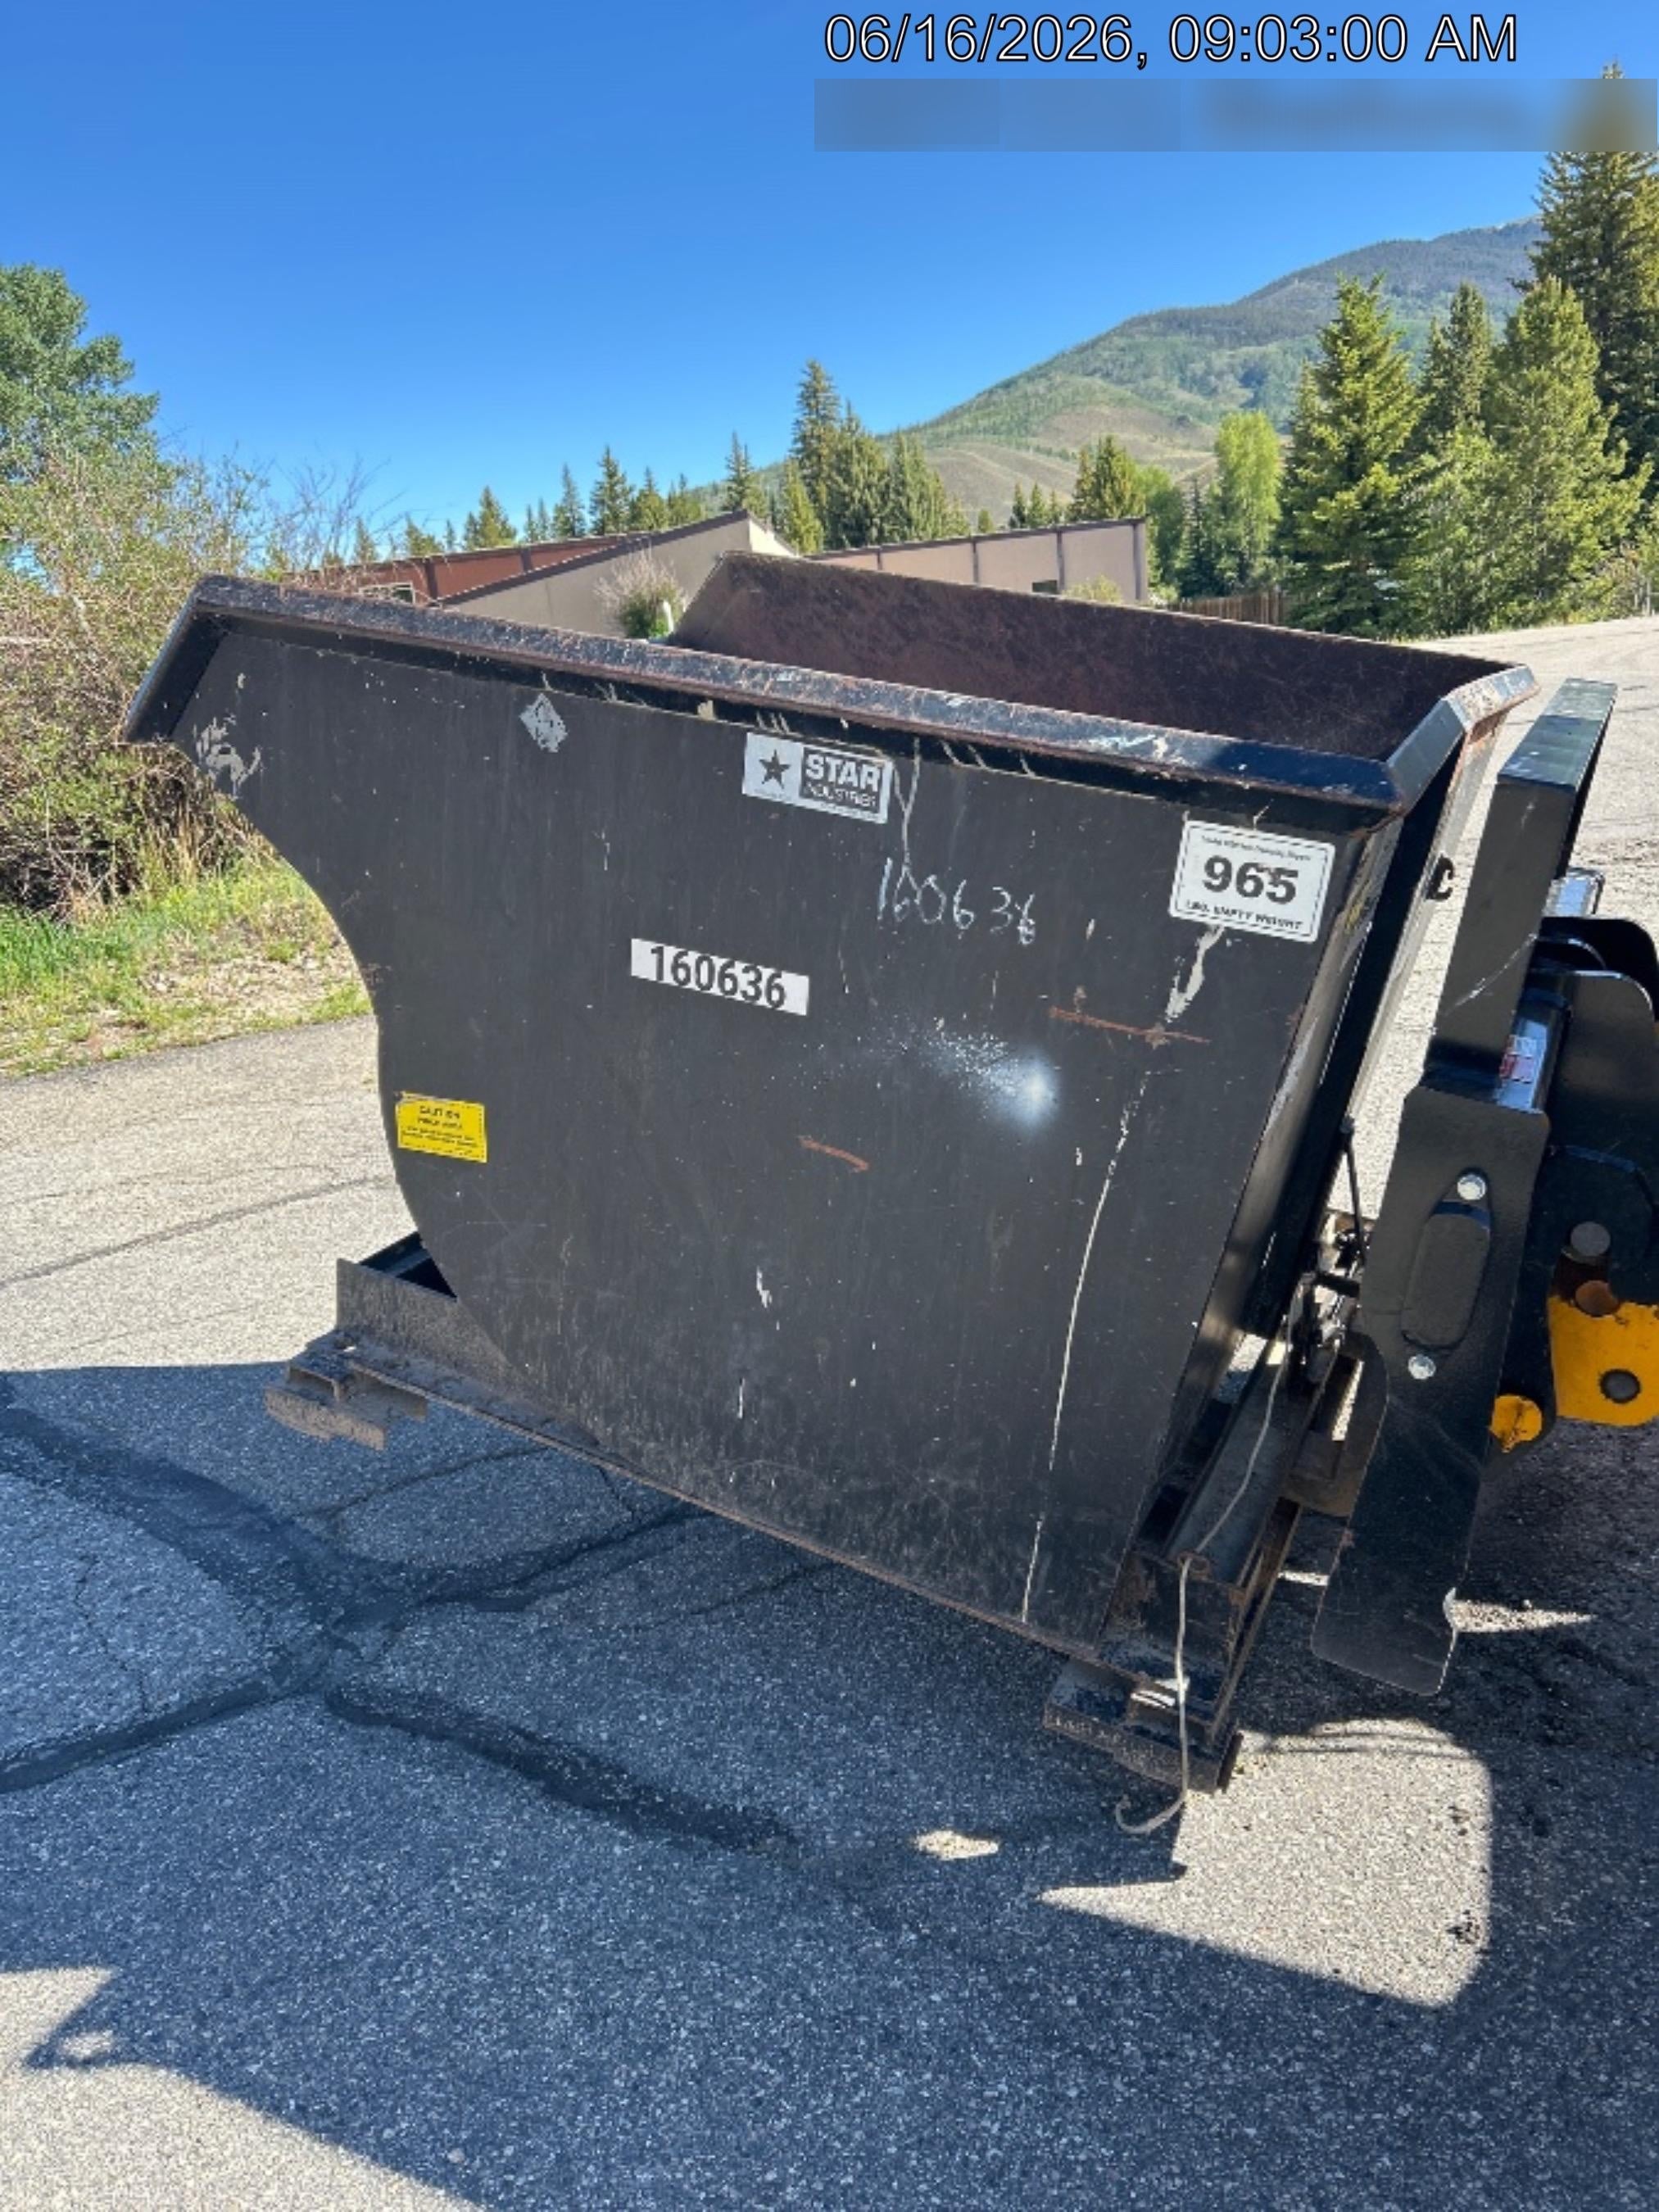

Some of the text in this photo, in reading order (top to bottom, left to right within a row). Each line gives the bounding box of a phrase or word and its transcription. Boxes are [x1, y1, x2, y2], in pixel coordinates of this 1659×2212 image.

[805, 753, 881, 793] STAR
[1202, 854, 1299, 904] 965
[1213, 905, 1253, 920] EMPTY
[650, 945, 786, 1009] 160636
